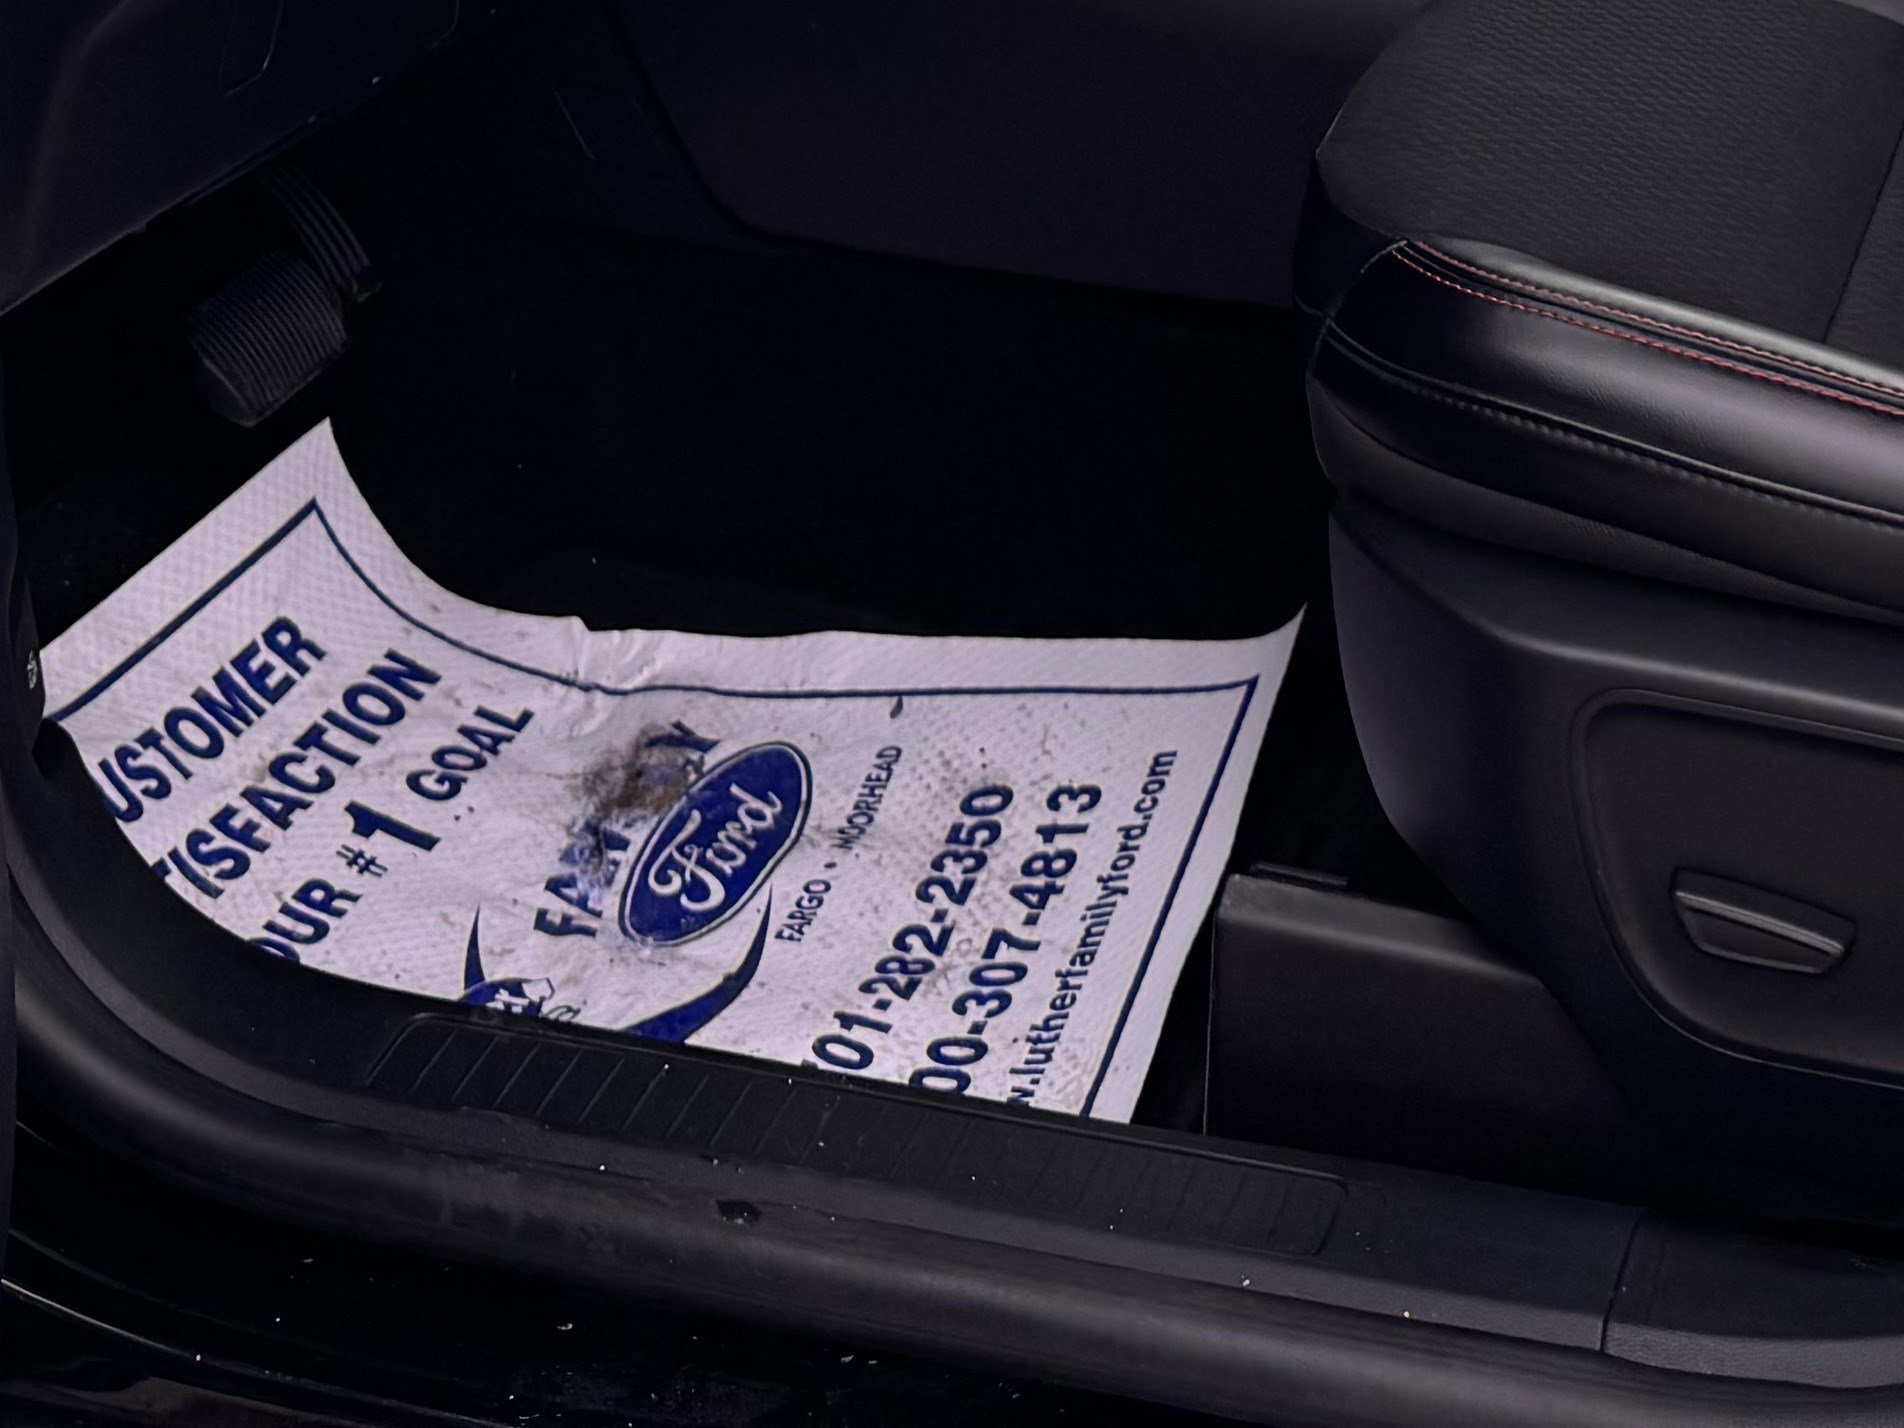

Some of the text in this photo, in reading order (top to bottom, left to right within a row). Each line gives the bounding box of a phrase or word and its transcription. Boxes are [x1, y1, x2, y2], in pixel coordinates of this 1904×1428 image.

[98, 616, 326, 823] USTOMER
[151, 648, 441, 899] ISFACTION
[406, 705, 535, 801] GOAL
[647, 783, 784, 912] Ford
[774, 745, 903, 943] FARGO MOORHEAD
[801, 783, 1015, 1071] 01-282-2350
[908, 783, 1103, 1094] 00-307-4813
[1006, 749, 1179, 1106] w.lutherfamilyford.com
